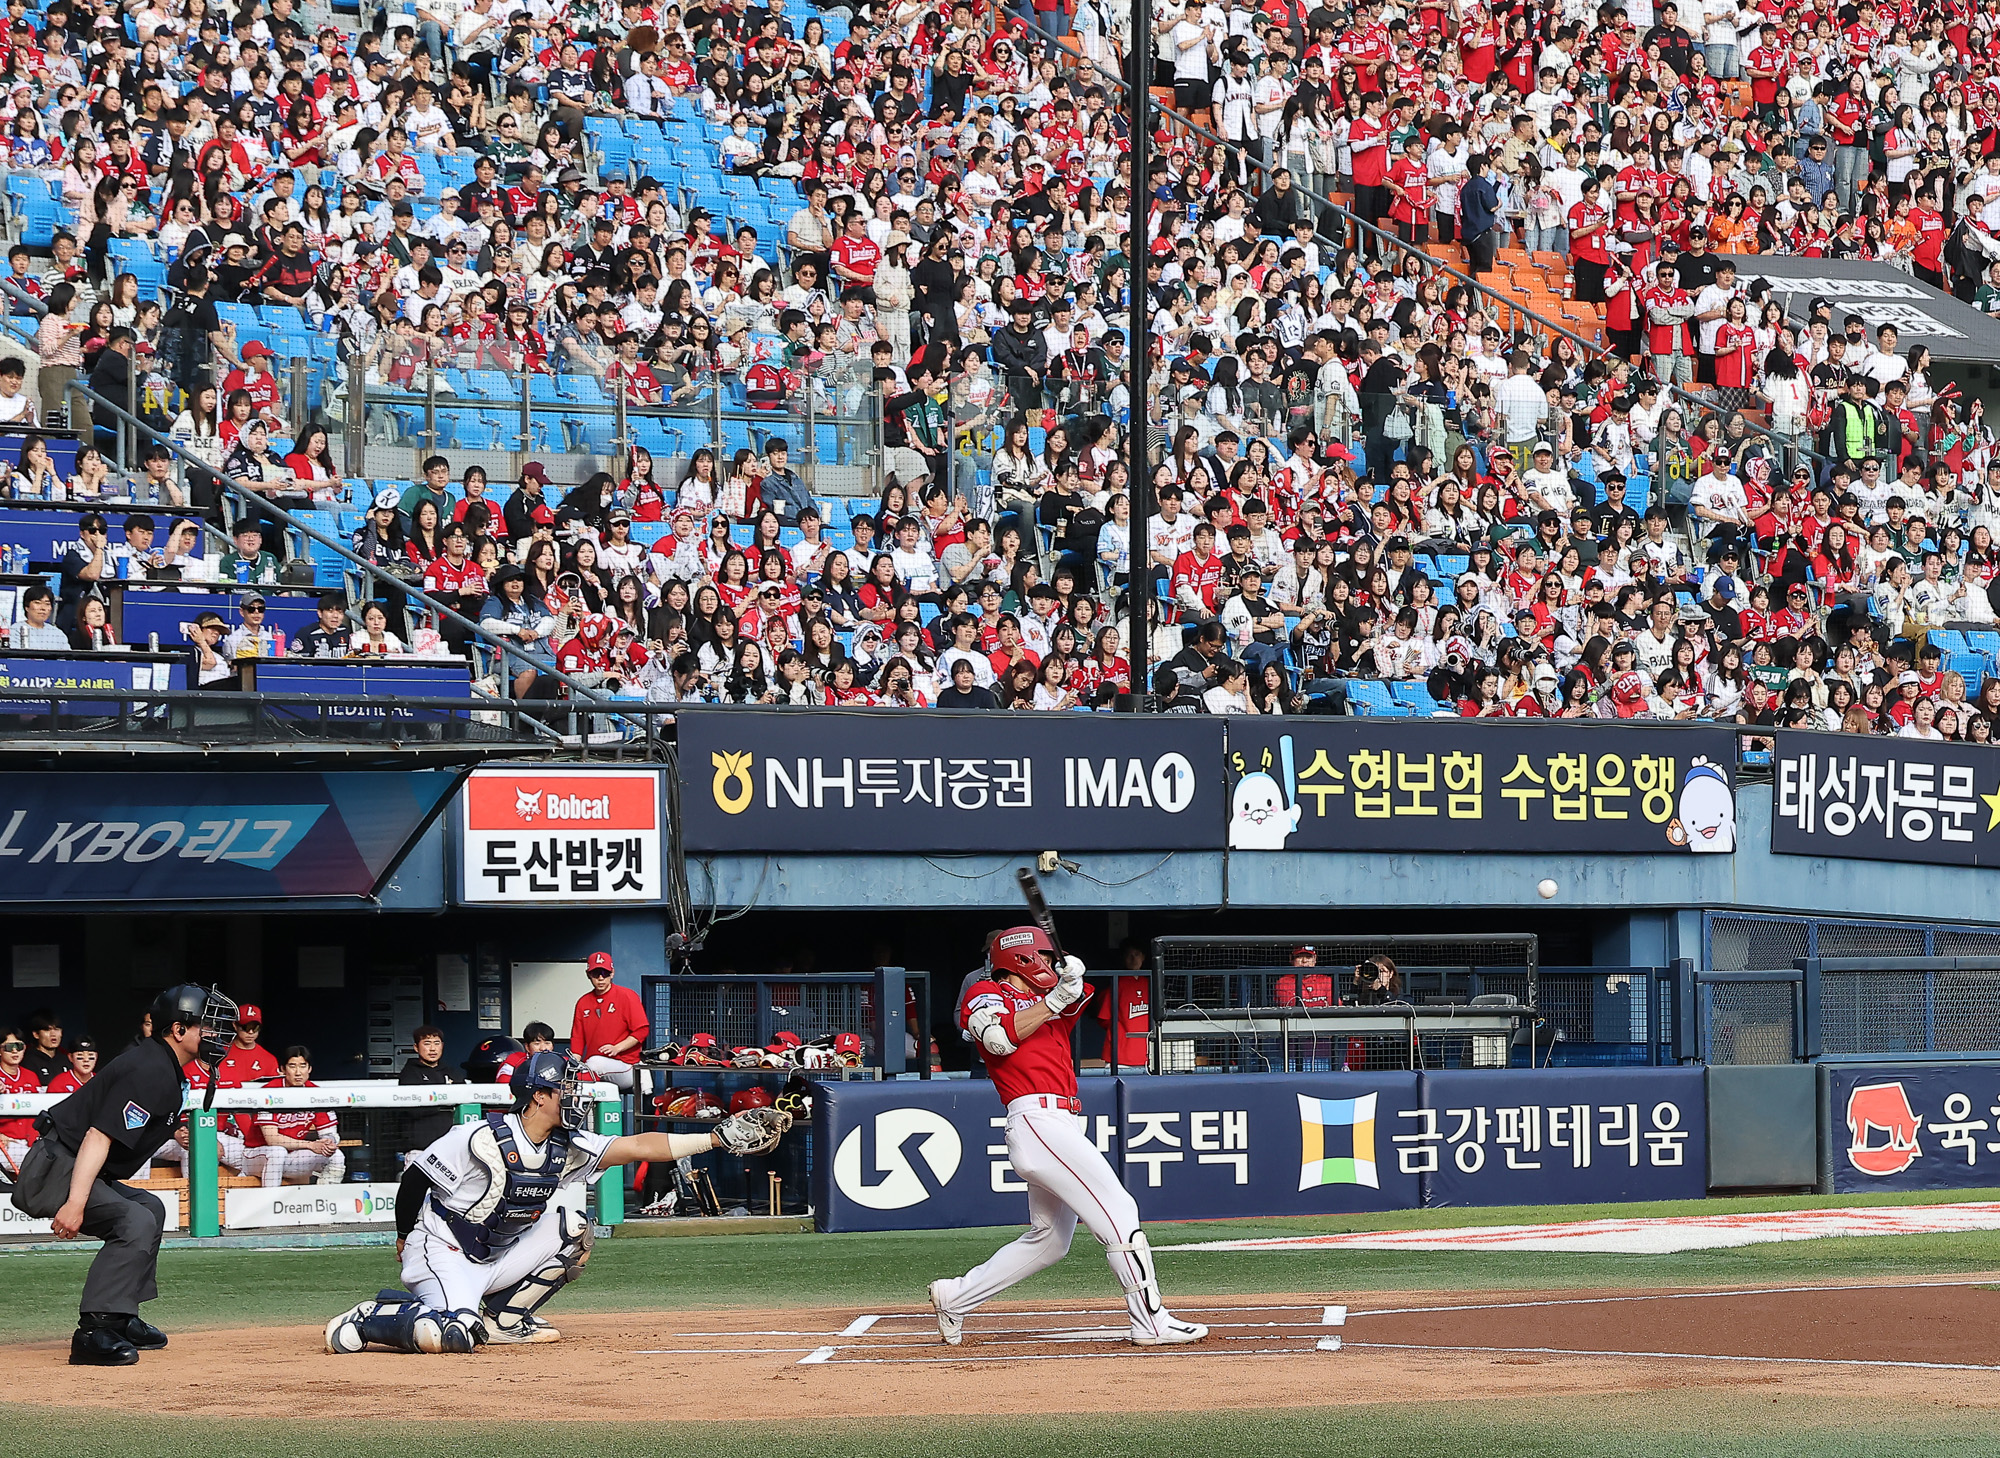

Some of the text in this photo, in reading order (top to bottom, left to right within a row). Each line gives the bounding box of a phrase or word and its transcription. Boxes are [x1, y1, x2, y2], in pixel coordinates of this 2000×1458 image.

[849, 248, 877, 266] Landers
[766, 756, 1033, 810] NH투자증권
[1298, 748, 1676, 824] 수협보험 수협은행
[1780, 753, 1979, 843] 태성자동문
[547, 793, 610, 822] Bobcat
[28, 820, 292, 865] KBO리그
[482, 837, 643, 893] 두산밥캣
[1002, 933, 1031, 944] TRADERS
[228, 1096, 284, 1106] Dream Big DB
[310, 1094, 366, 1105] Dream Big DB
[393, 1093, 448, 1103] Dream Big DB
[473, 1092, 502, 1101] Dream Big
[199, 1117, 216, 1128] DB
[604, 1112, 620, 1123] DB
[1391, 1101, 1690, 1176] 금강펜테리움
[514, 1186, 553, 1198] 두산테스나
[273, 1197, 396, 1215] Dream Big DB
